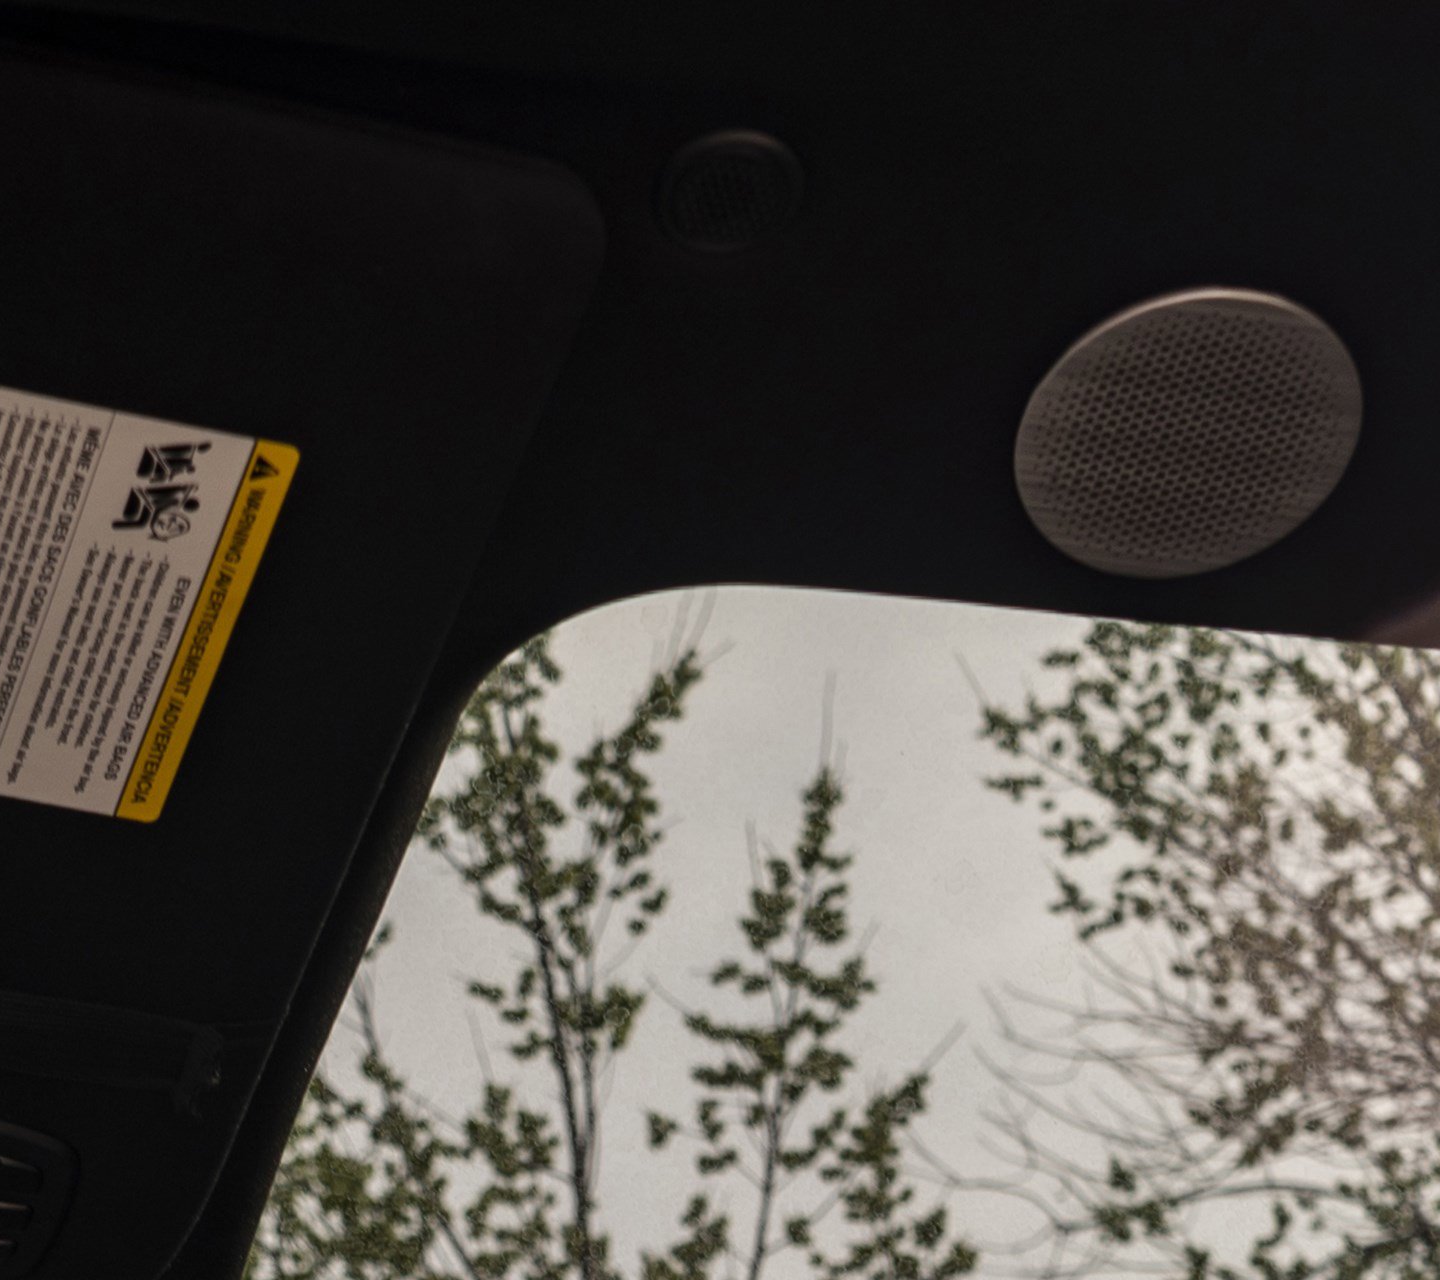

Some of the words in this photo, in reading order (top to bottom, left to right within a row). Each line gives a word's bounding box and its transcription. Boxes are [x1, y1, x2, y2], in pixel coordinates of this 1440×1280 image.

[165, 576, 192, 614] EVEN
[152, 614, 177, 650] WITH
[125, 650, 164, 721] ADVANCED
